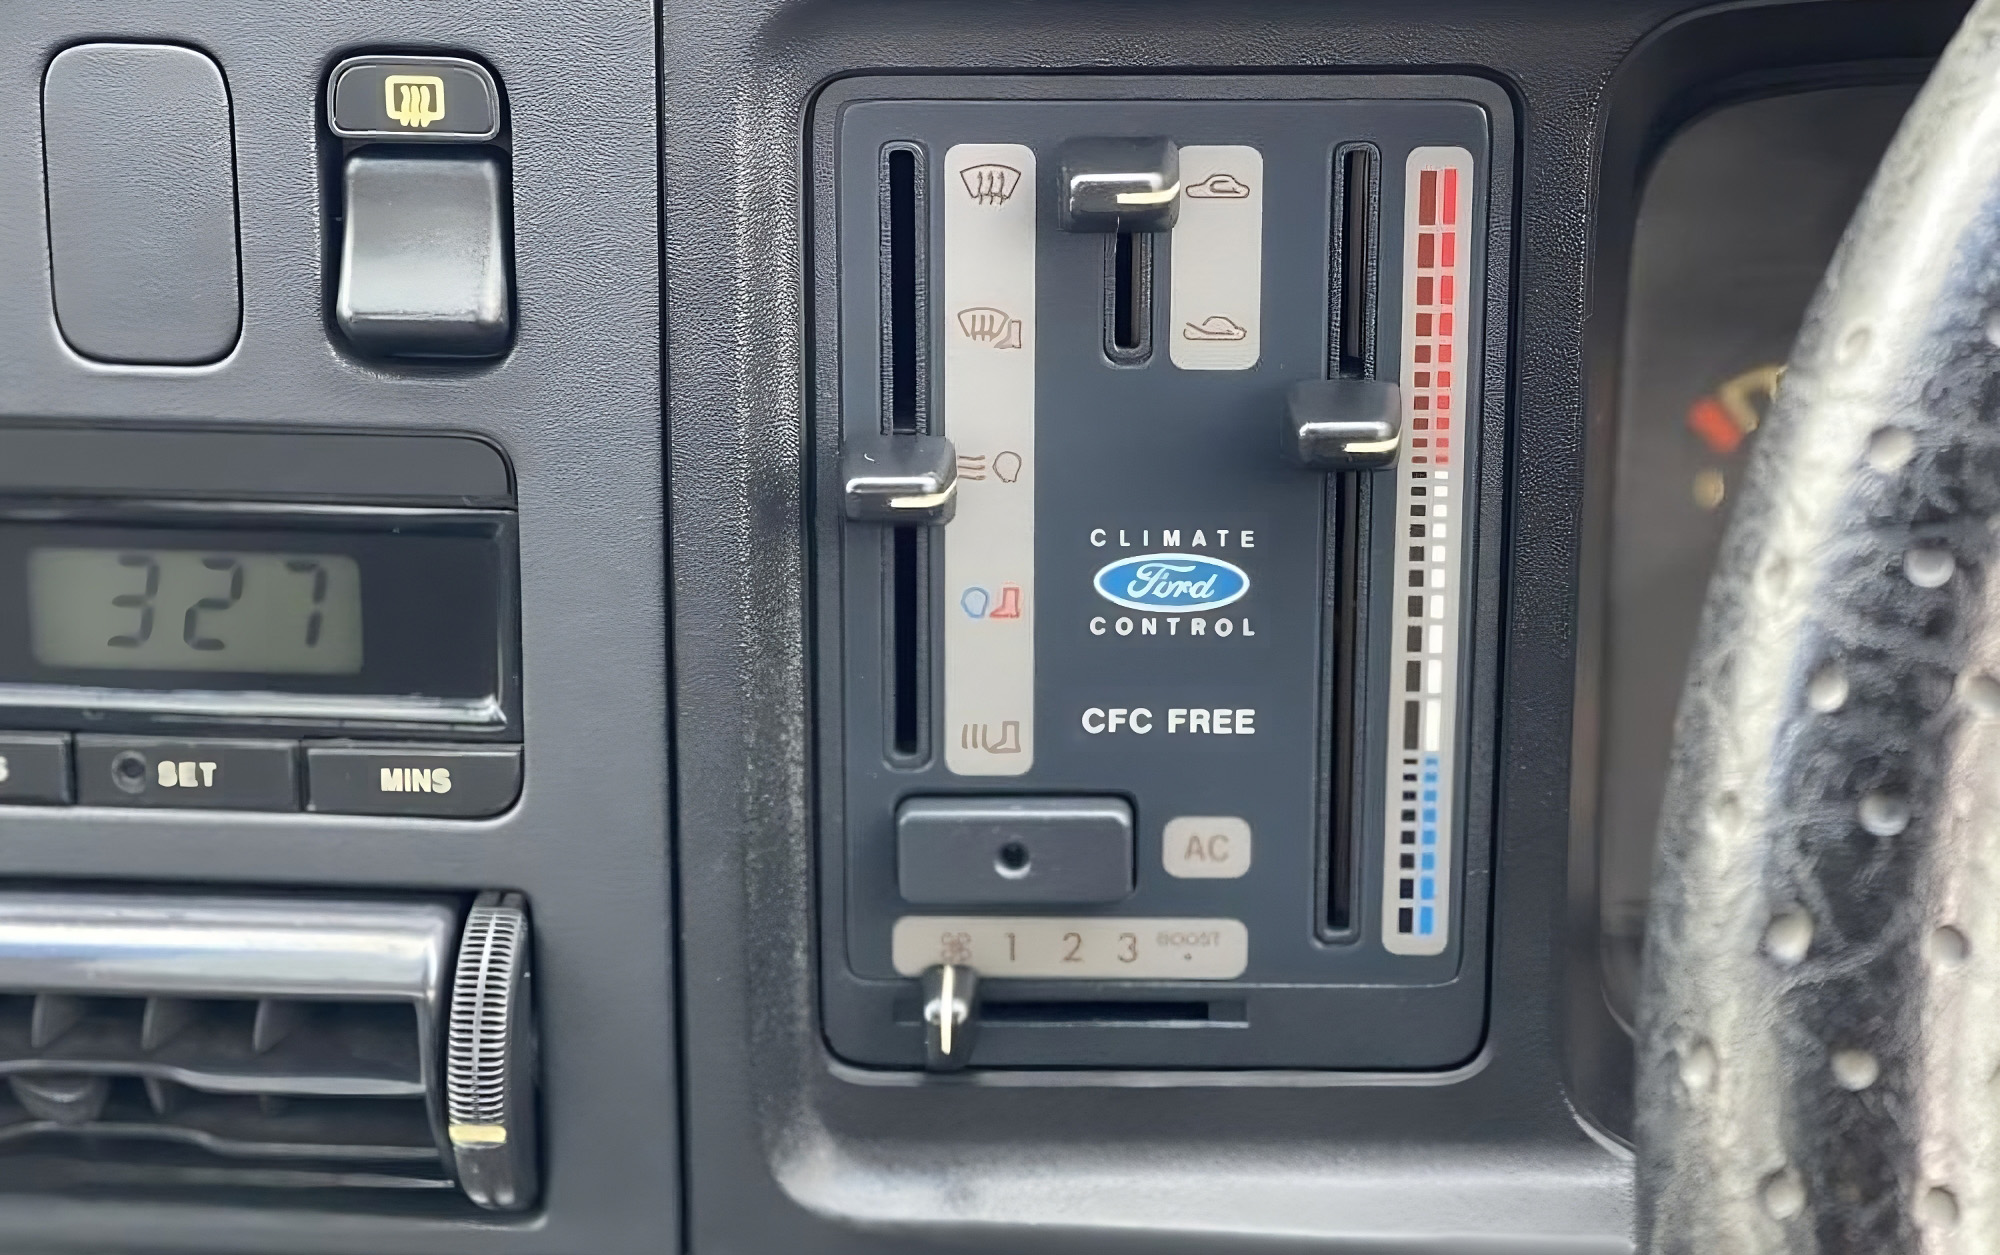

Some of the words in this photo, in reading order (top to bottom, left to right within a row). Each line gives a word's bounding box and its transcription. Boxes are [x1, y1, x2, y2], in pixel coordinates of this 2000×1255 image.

[1090, 528, 1255, 548] CLIMATE
[1127, 562, 1218, 599] Ford
[1089, 616, 1256, 637] CONTROL
[1081, 707, 1153, 734] CFC
[1167, 708, 1256, 735] FREE
[157, 761, 217, 788] SET
[380, 768, 452, 794] MINS
[1184, 834, 1229, 862] AC
[1005, 932, 1016, 961] 1
[1062, 932, 1083, 962] 2
[1117, 932, 1138, 962] 3
[1156, 931, 1221, 948] BOOST
